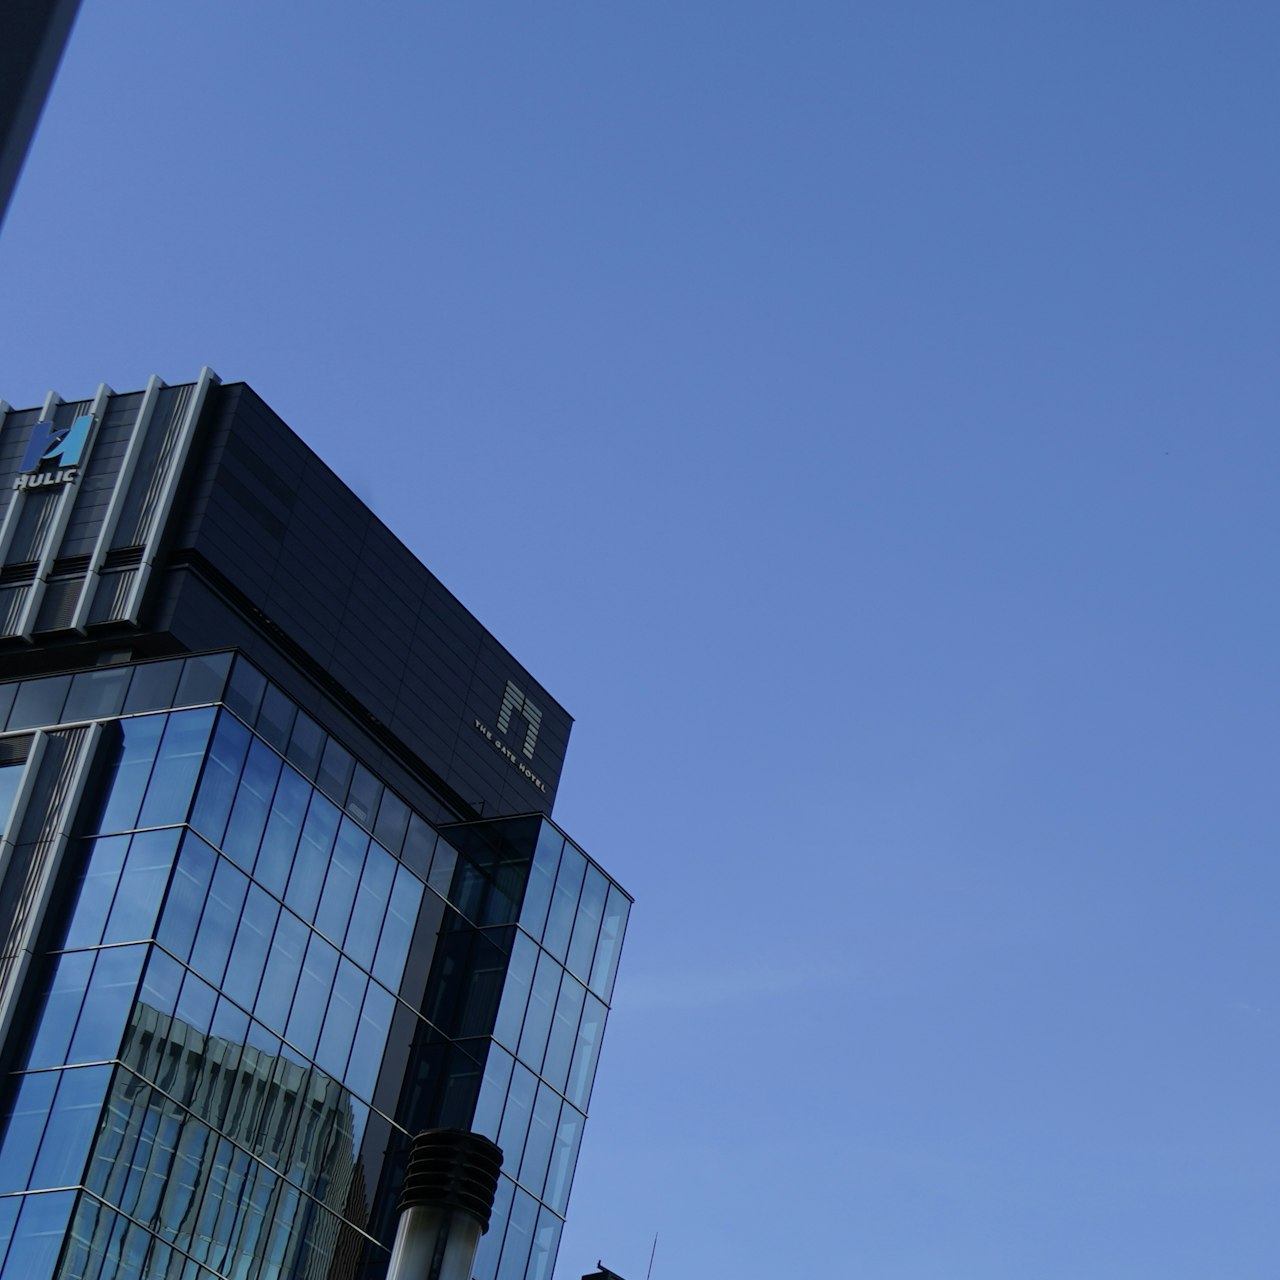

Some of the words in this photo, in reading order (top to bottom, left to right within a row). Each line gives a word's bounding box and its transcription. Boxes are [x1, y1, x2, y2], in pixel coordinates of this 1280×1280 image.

[13, 468, 77, 490] HULIC
[475, 719, 493, 741] THE
[494, 740, 517, 764] GATE
[519, 763, 546, 793] HOTEL
